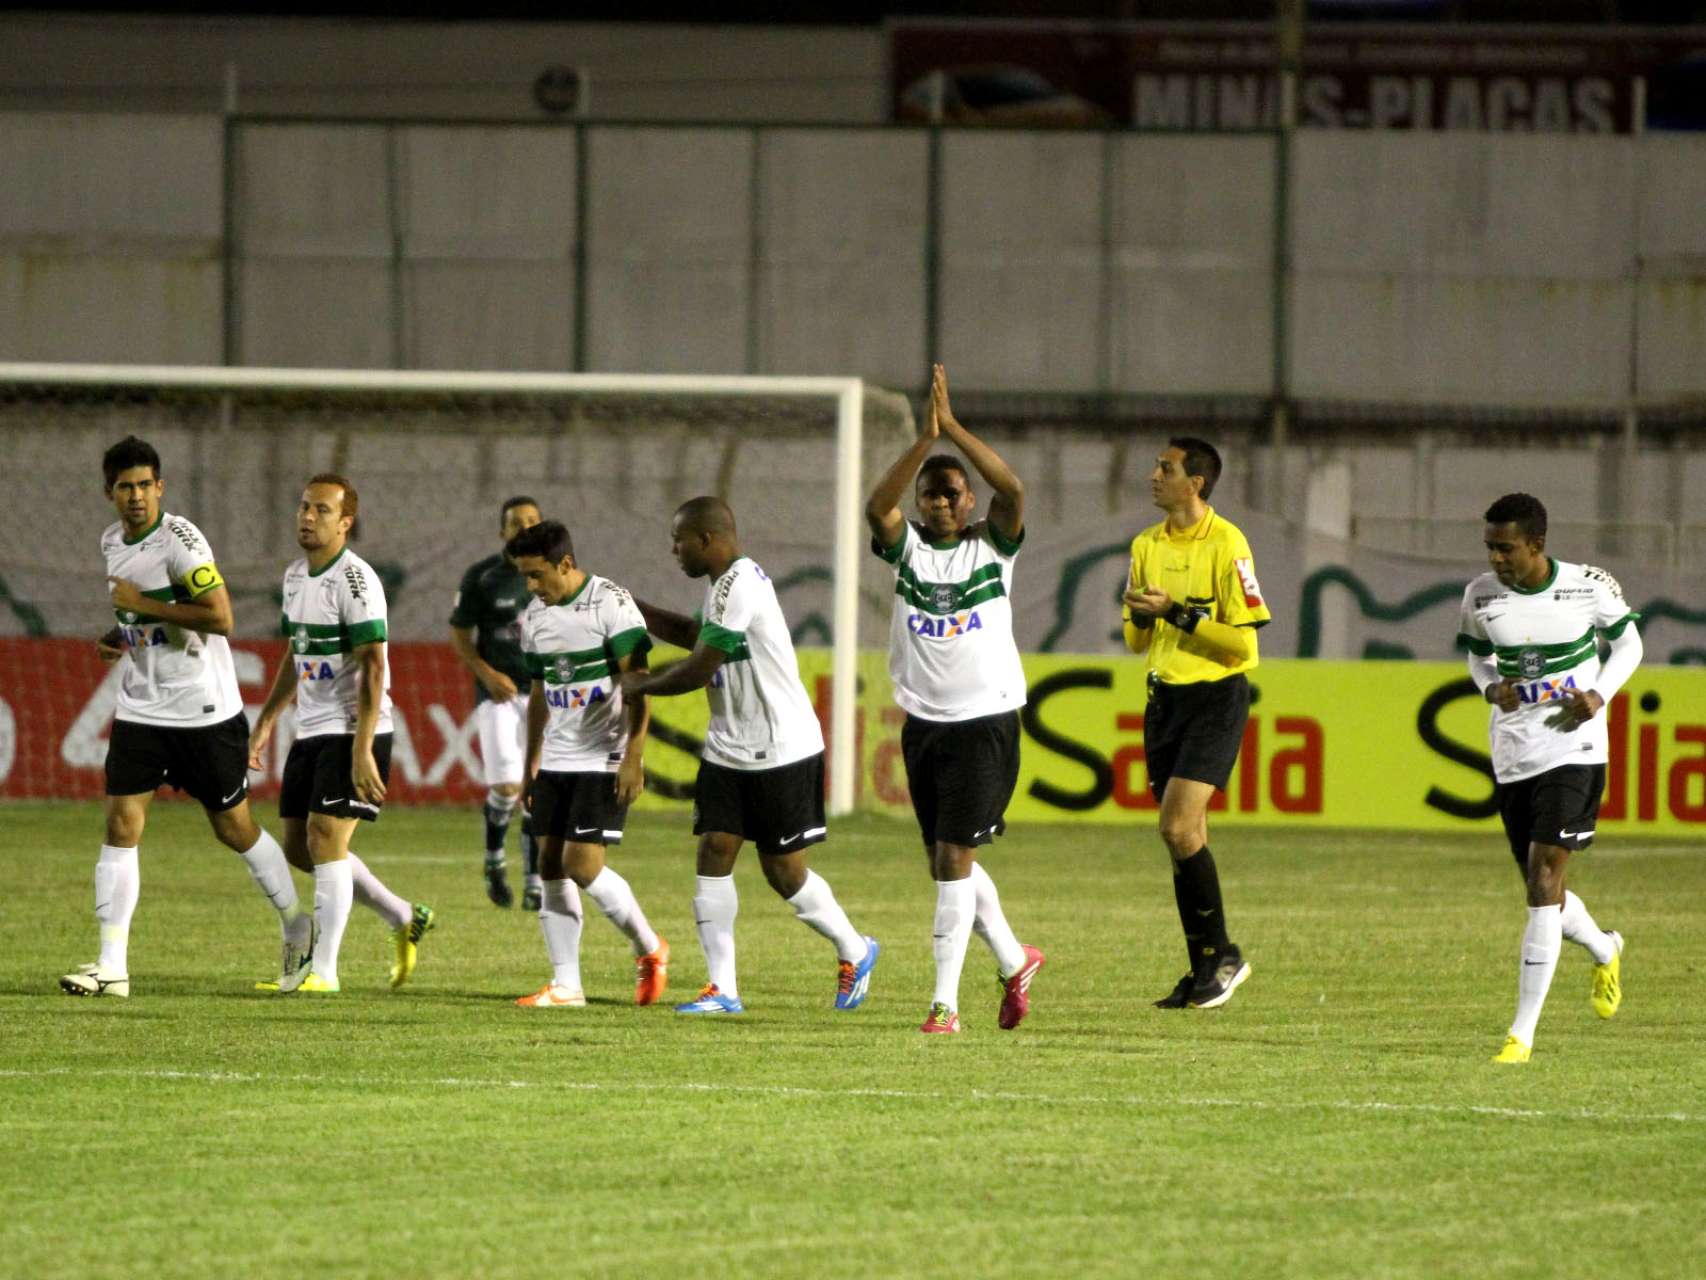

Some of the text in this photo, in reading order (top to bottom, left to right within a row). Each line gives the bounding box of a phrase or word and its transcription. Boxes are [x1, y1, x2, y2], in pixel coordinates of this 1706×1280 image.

[192, 566, 216, 588] C
[908, 610, 983, 638] CAIXA
[546, 685, 606, 709] CAIXA
[1515, 675, 1577, 704] AIXA
[1021, 667, 1323, 814] Saia
